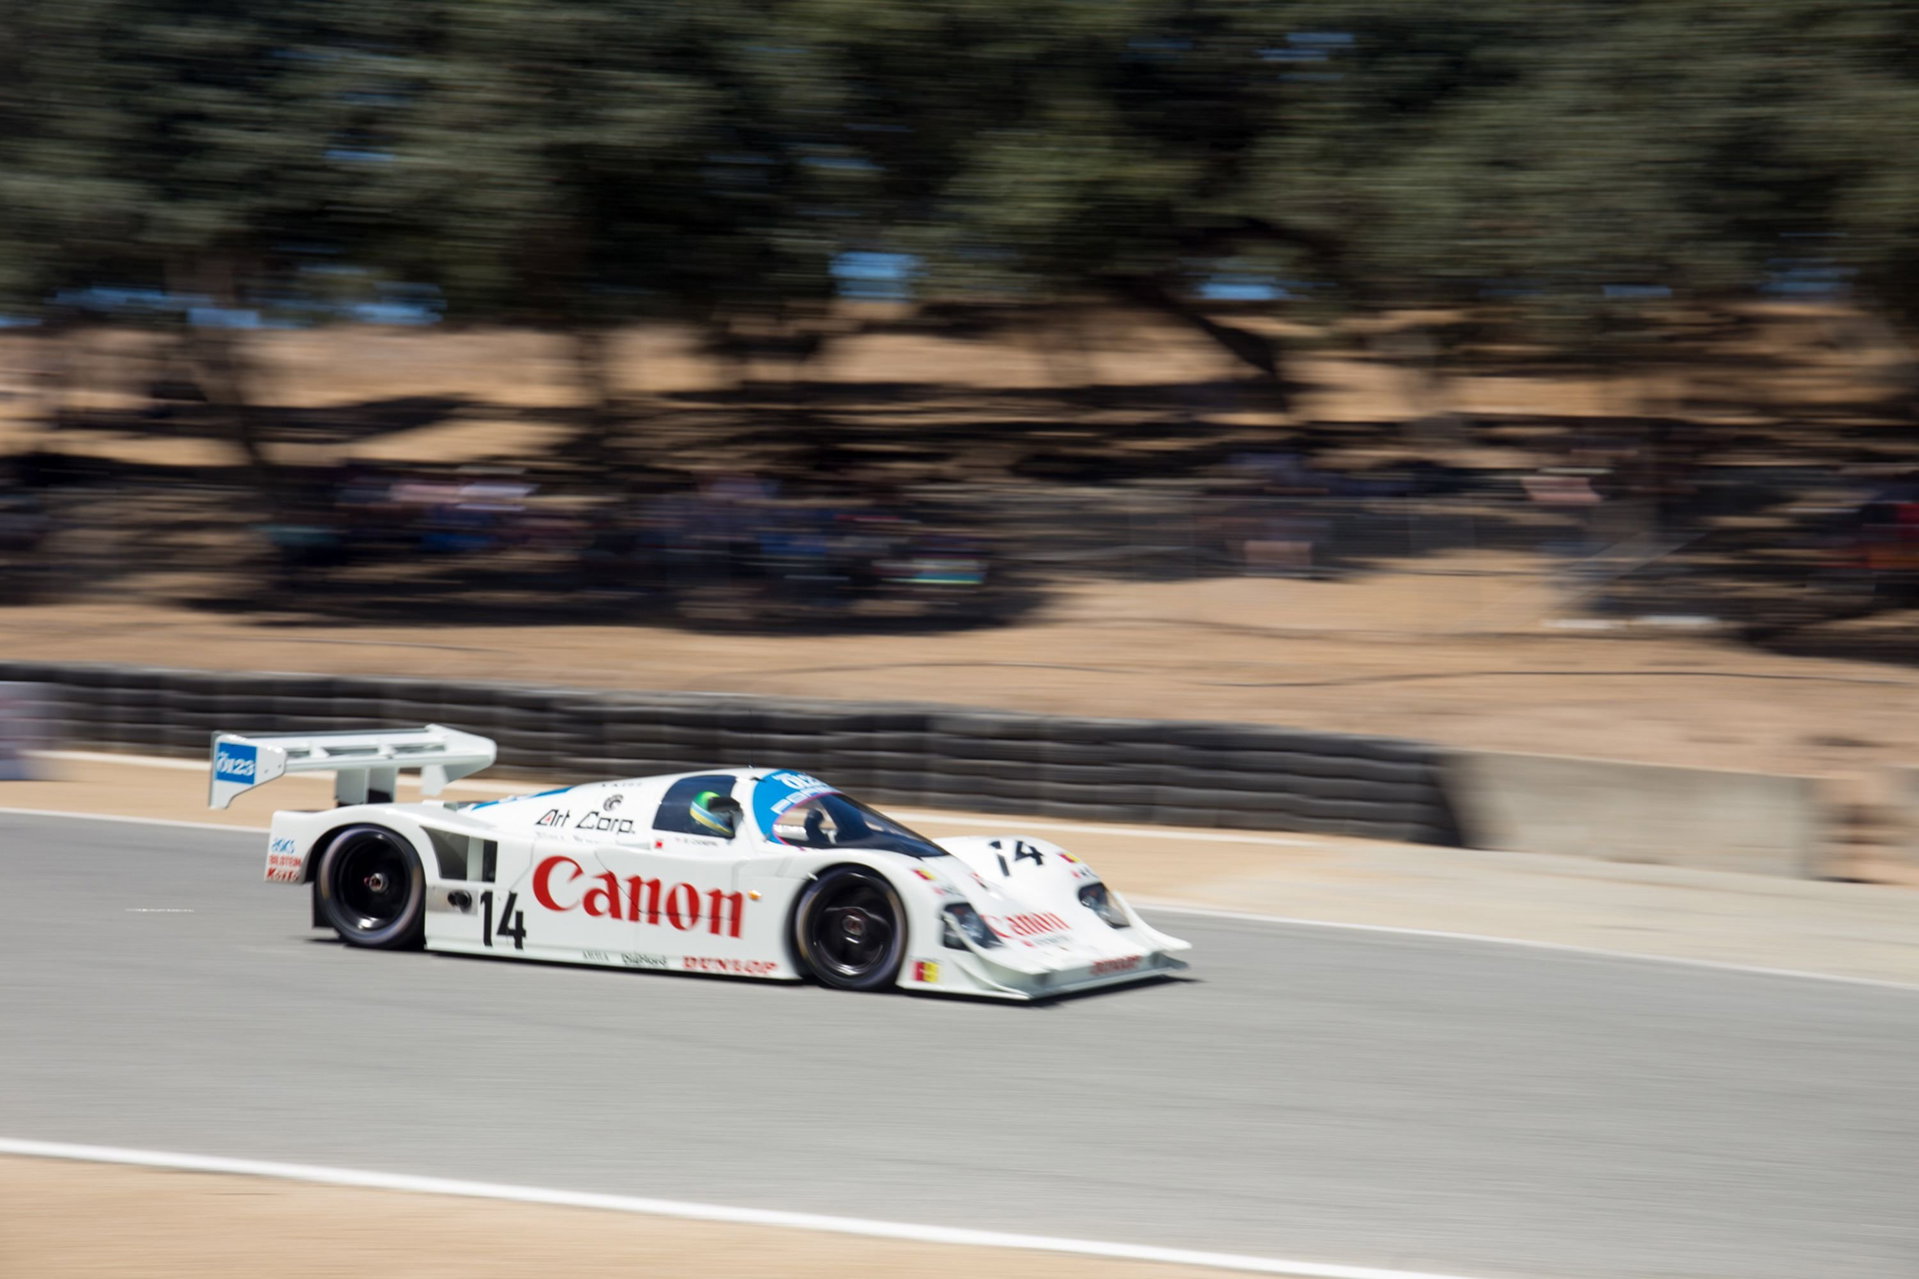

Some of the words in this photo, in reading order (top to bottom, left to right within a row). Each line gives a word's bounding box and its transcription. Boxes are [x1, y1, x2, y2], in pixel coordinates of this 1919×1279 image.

[535, 808, 570, 827] Art
[988, 840, 1043, 877] 14
[533, 855, 744, 938] Canon
[480, 890, 526, 950] 14
[977, 911, 1072, 939] Canon
[682, 955, 777, 975] DUNLOP
